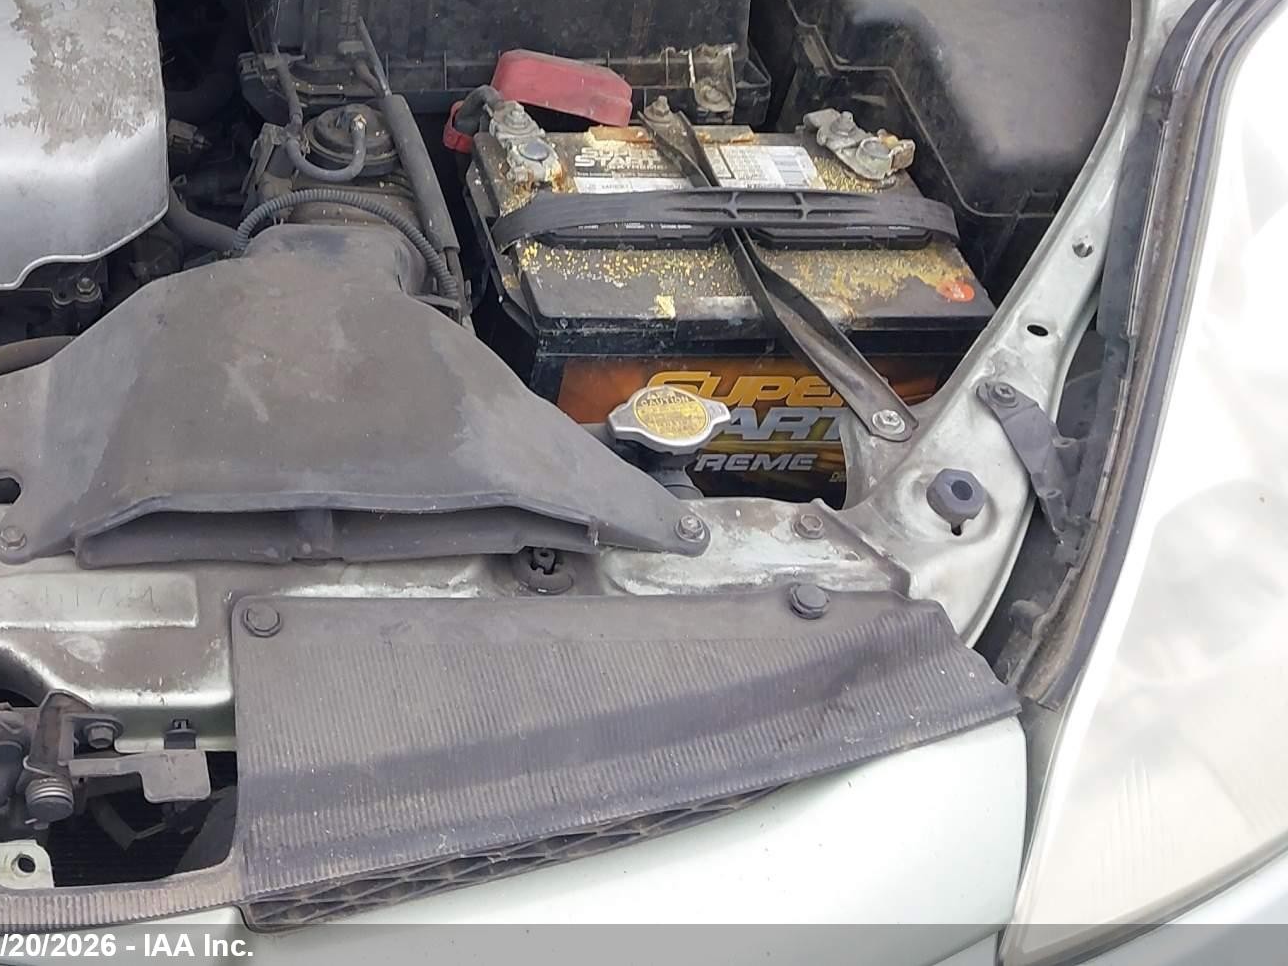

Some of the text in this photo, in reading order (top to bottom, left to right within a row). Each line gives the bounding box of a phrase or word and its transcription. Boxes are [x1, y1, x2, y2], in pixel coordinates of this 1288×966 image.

[647, 370, 845, 408] SUPE
[710, 407, 842, 440] ART
[693, 453, 819, 473] REME
